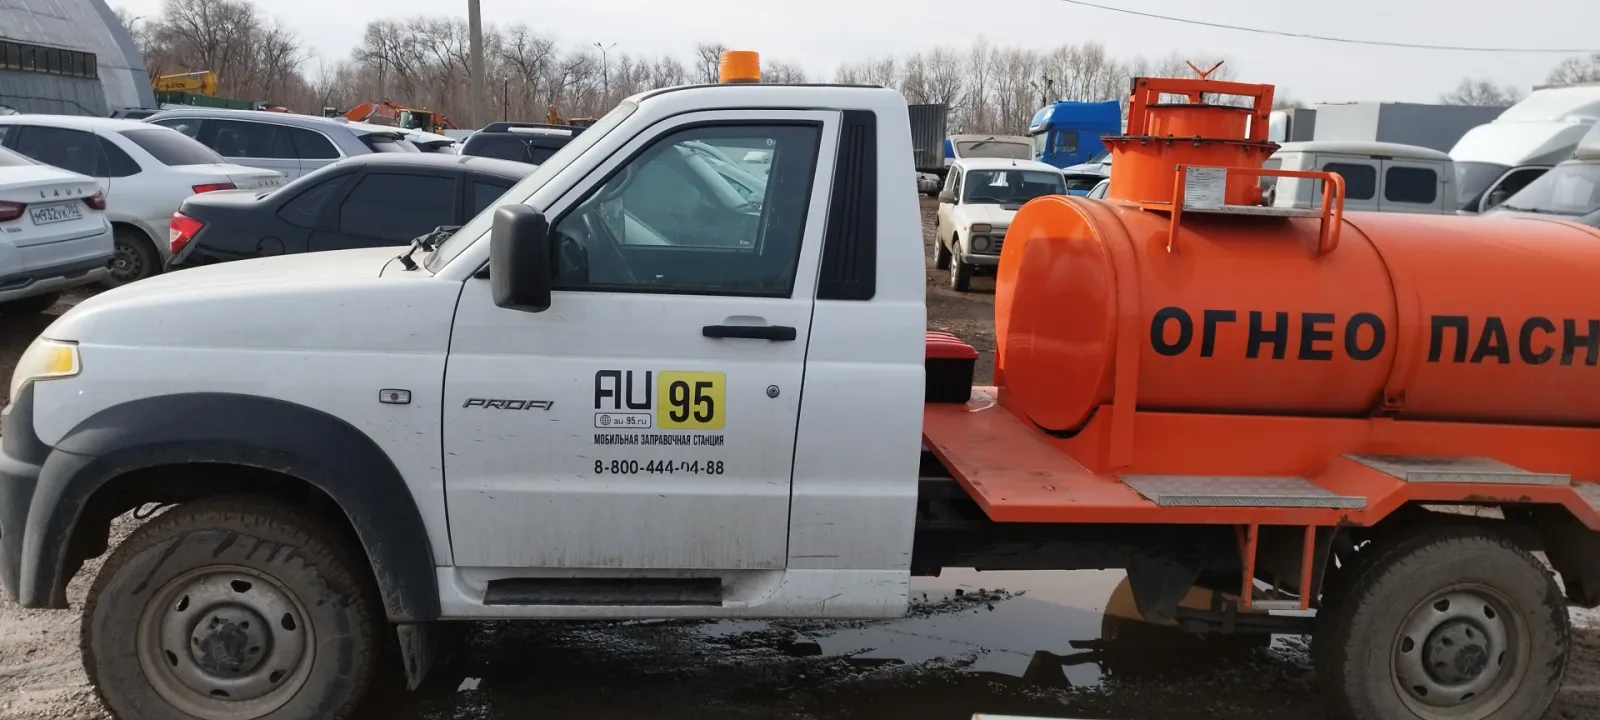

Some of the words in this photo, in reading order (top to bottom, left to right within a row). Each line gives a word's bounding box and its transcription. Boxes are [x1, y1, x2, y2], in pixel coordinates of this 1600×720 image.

[1150, 306, 1386, 361] ОГНЕО
[1427, 314, 1600, 367] ПАСН
[462, 397, 555, 412] PROFI
[668, 380, 715, 424] 95
[594, 434, 639, 446] МОБИЛЬНАЯ
[640, 434, 691, 447] ЗАПРАВОЧНАЯ
[693, 435, 724, 447] СТАНЦИЯ
